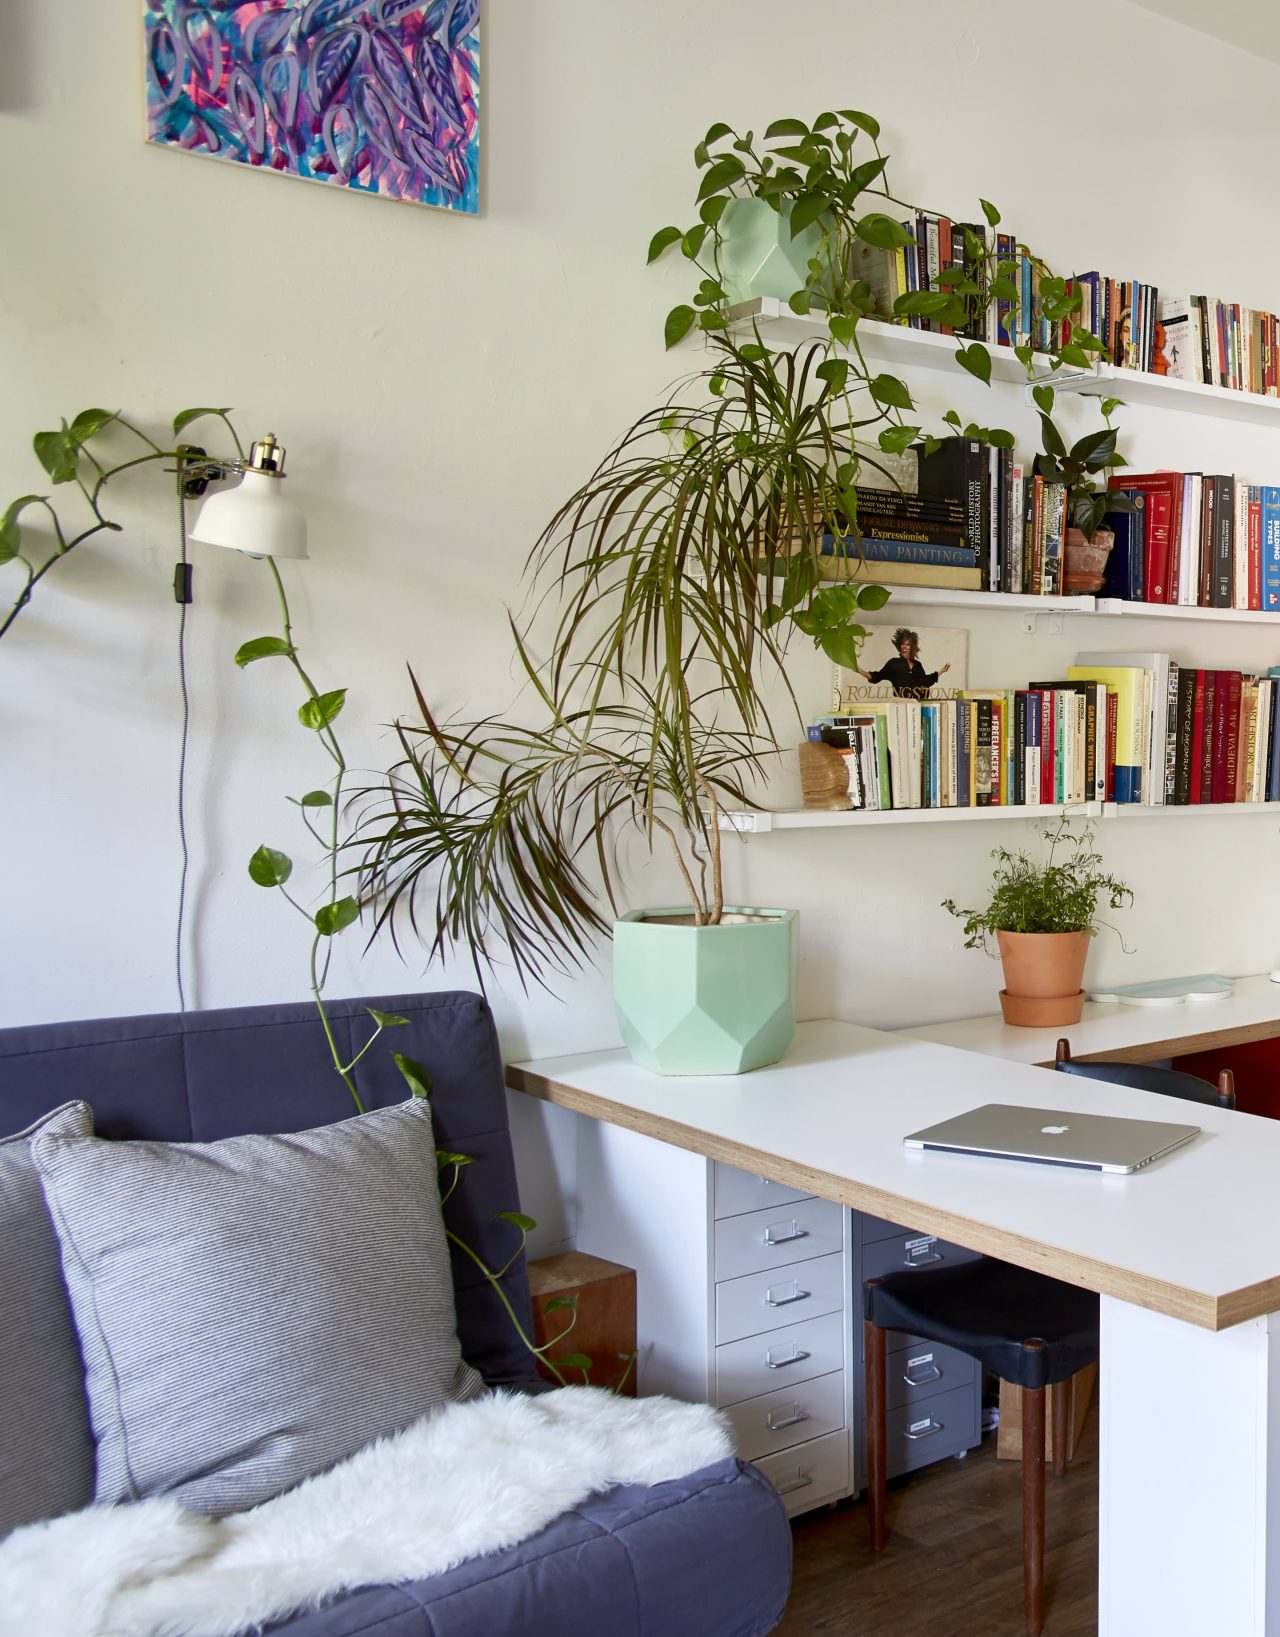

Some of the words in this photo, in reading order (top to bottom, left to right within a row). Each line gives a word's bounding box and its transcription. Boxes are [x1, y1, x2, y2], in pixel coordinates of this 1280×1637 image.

[929, 228, 937, 264] Beautiful
[871, 528, 929, 543] Expressionists
[898, 519, 940, 532] DRAWING
[834, 541, 889, 556] TAIAN
[897, 546, 962, 563] PAINTING
[975, 544, 980, 556] OF
[1185, 681, 1193, 719] HISTORY
[1185, 720, 1191, 731] OF
[1247, 725, 1256, 767] HISTORY
[1227, 733, 1236, 784] MEDIEVAL
